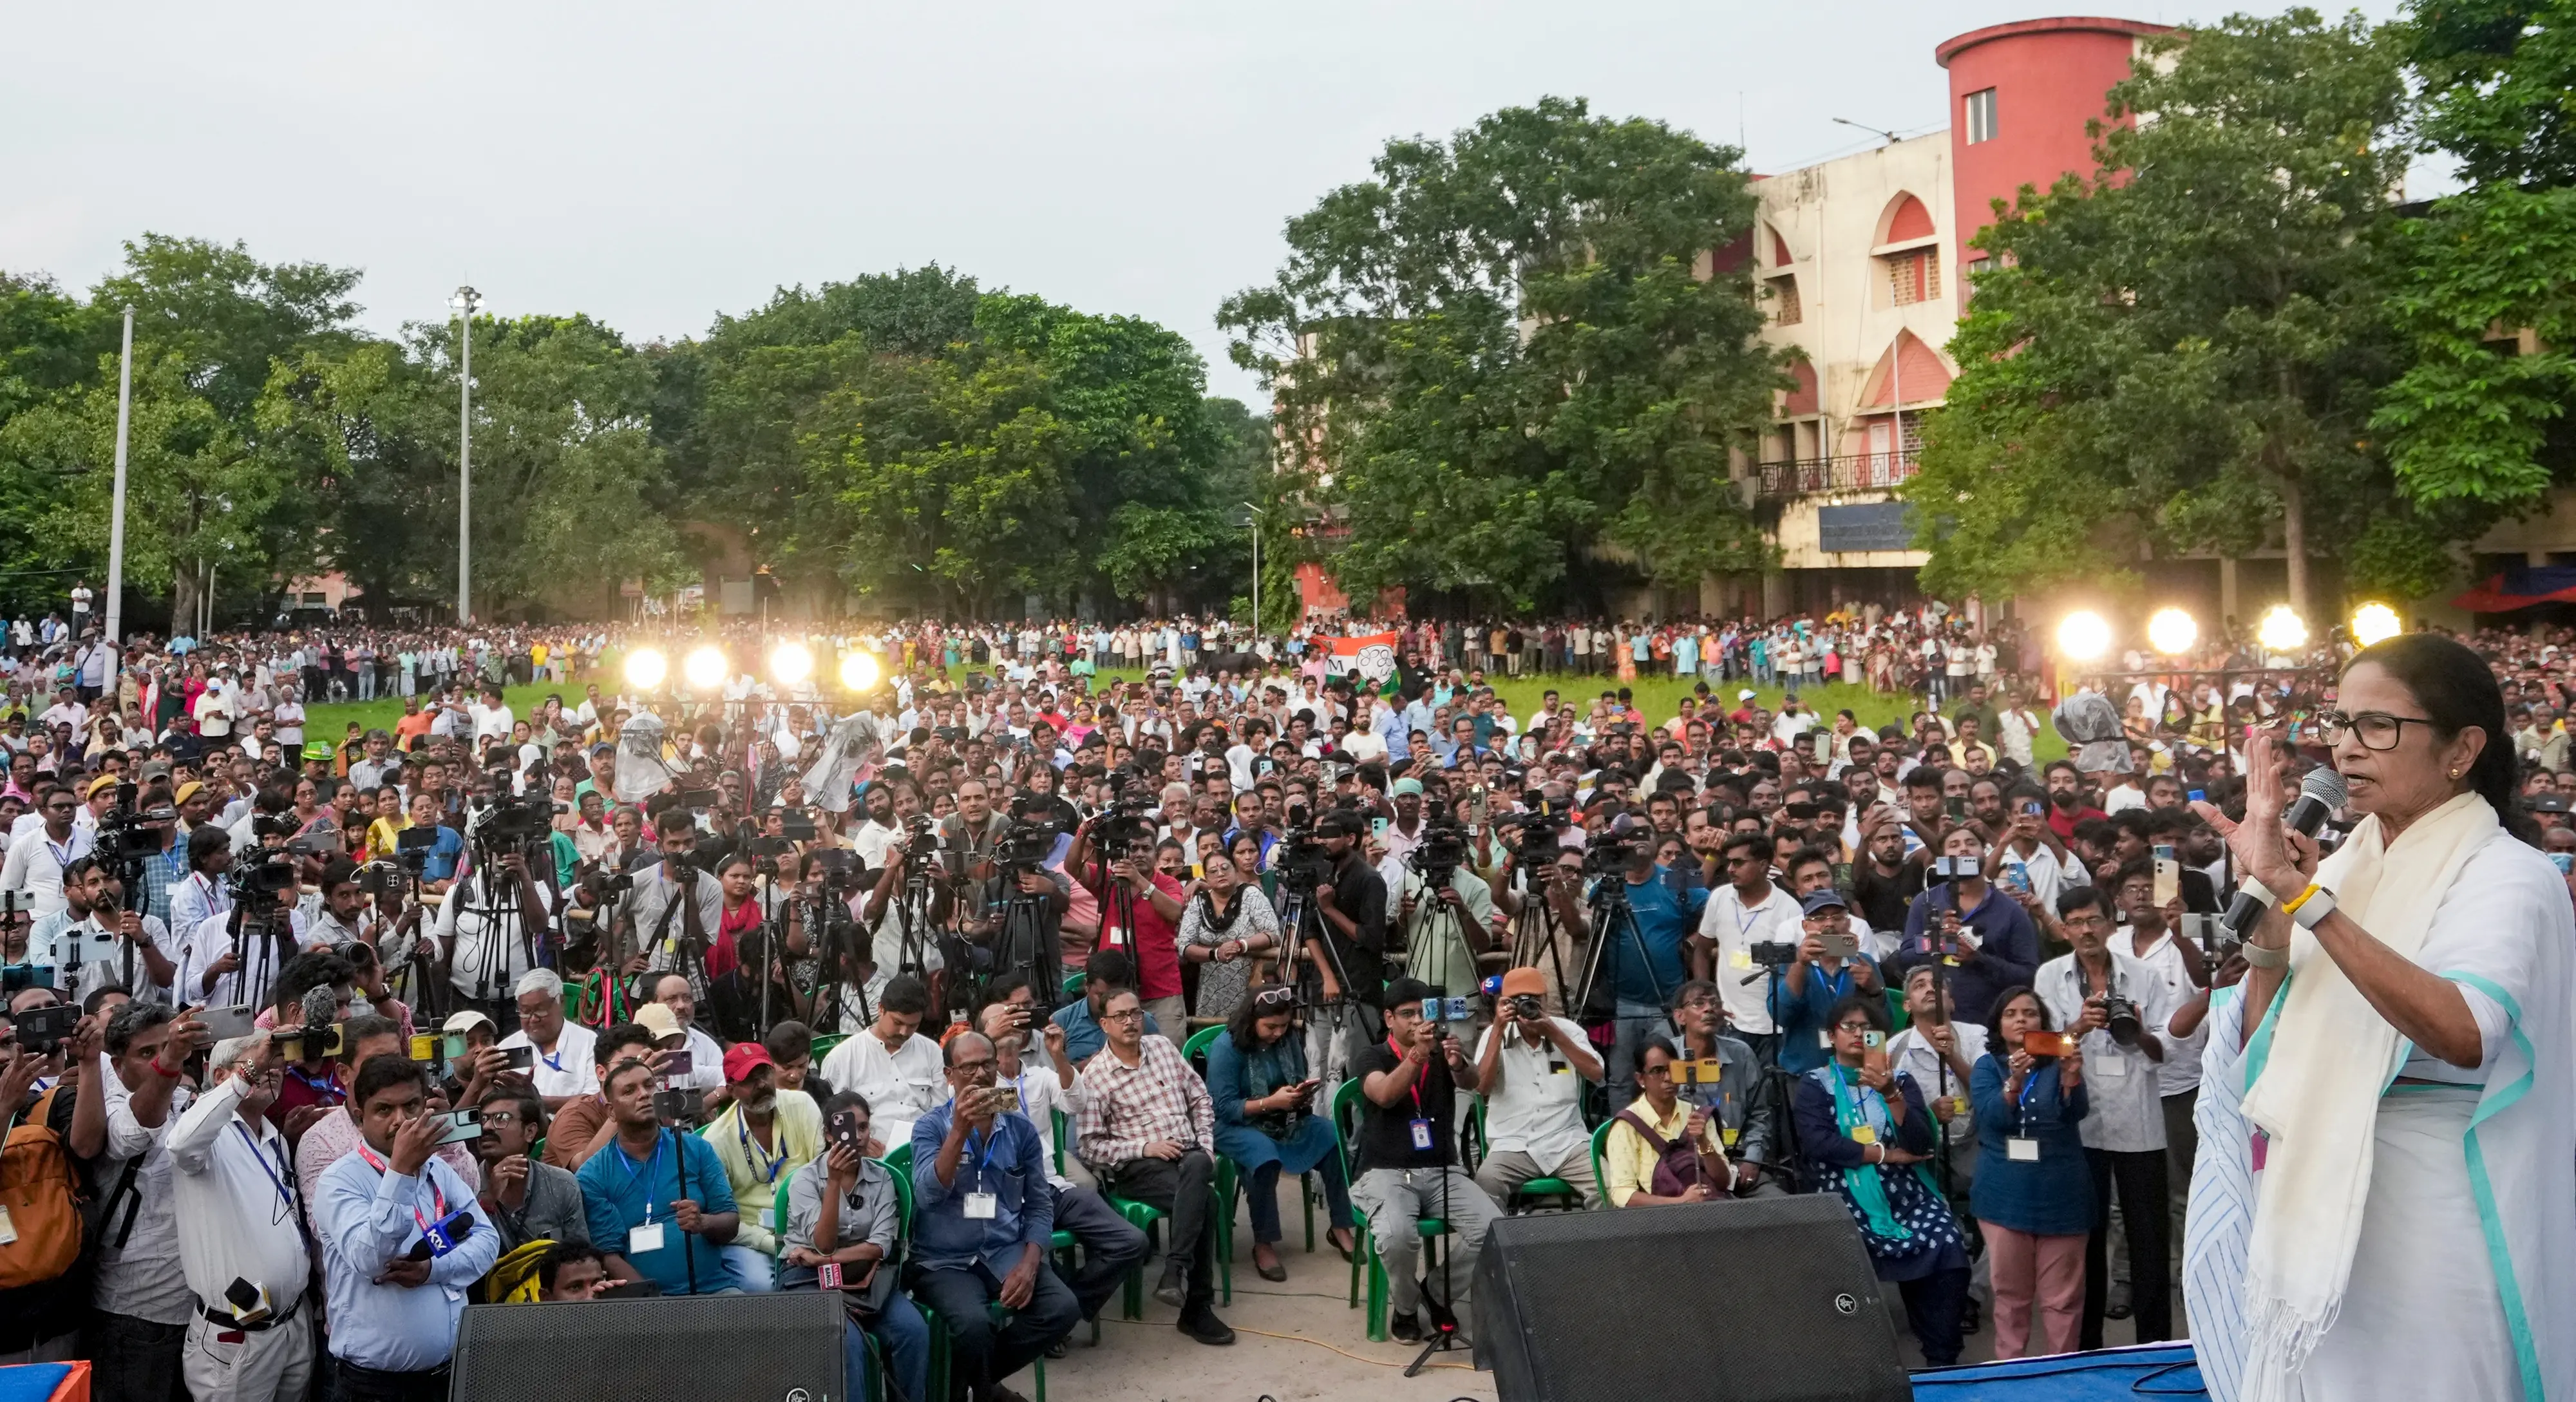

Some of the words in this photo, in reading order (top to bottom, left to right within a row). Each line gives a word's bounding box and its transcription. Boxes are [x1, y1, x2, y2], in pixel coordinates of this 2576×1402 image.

[1328, 658, 1345, 672] M
[479, 807, 492, 823] ANI
[427, 1228, 447, 1249] KTV
